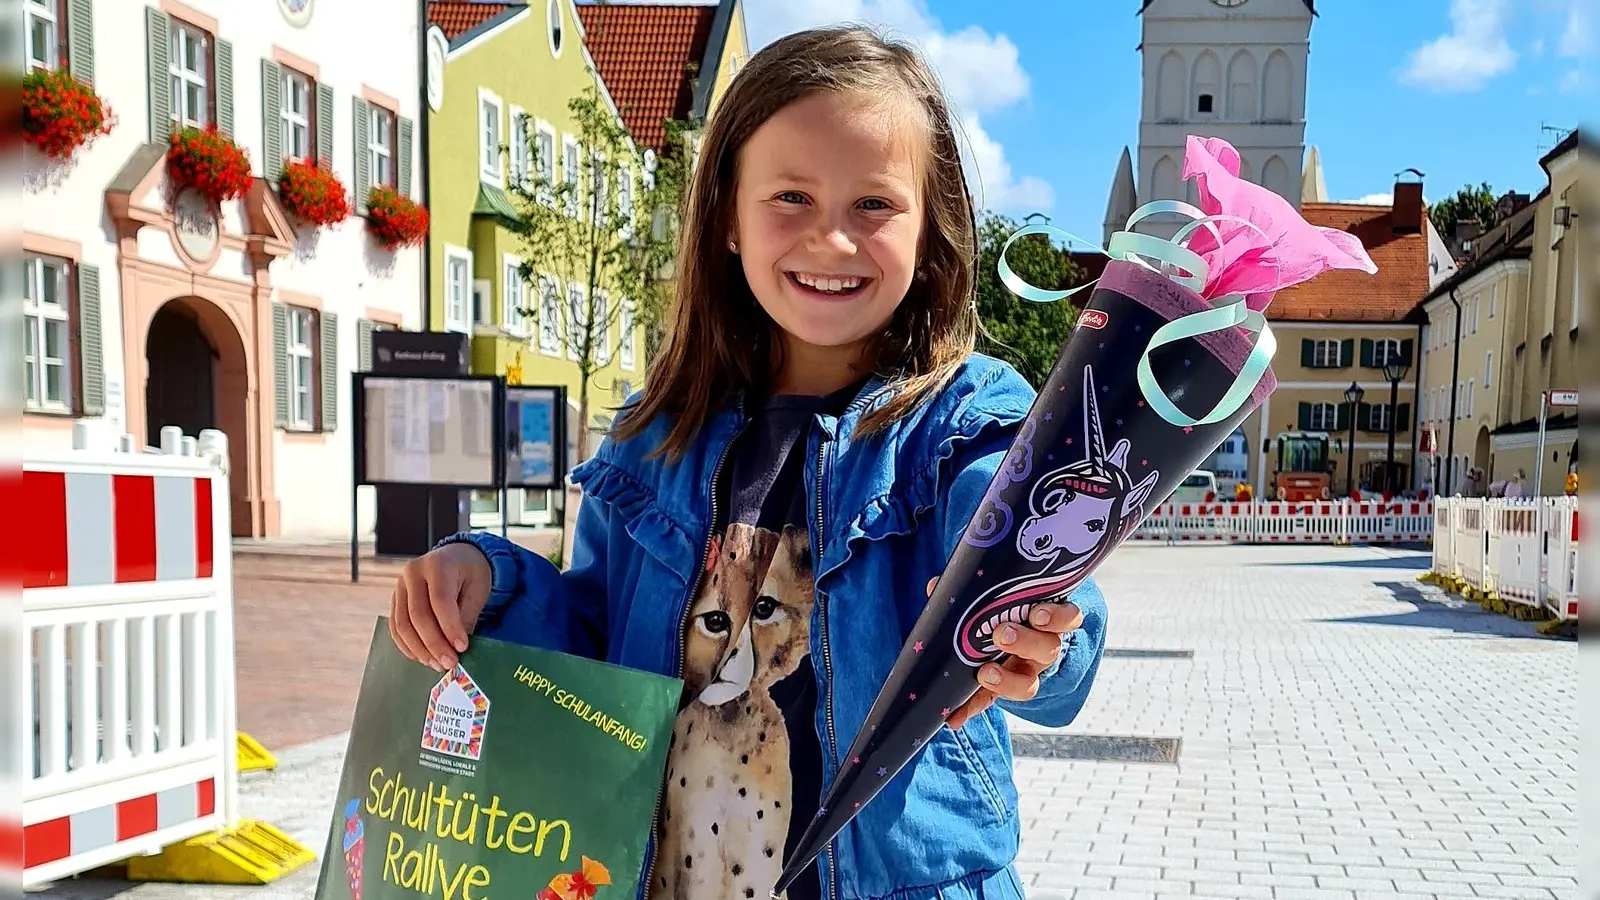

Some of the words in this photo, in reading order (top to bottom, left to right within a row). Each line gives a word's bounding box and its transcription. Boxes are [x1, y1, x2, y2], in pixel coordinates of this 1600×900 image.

[435, 713, 461, 728] BUNTE
[437, 703, 473, 719] ERDINGS
[513, 664, 556, 697] HAPPY
[553, 689, 647, 752] SCHULANFANG!
[365, 766, 571, 862] Schultüten
[383, 831, 490, 900] Rallye
